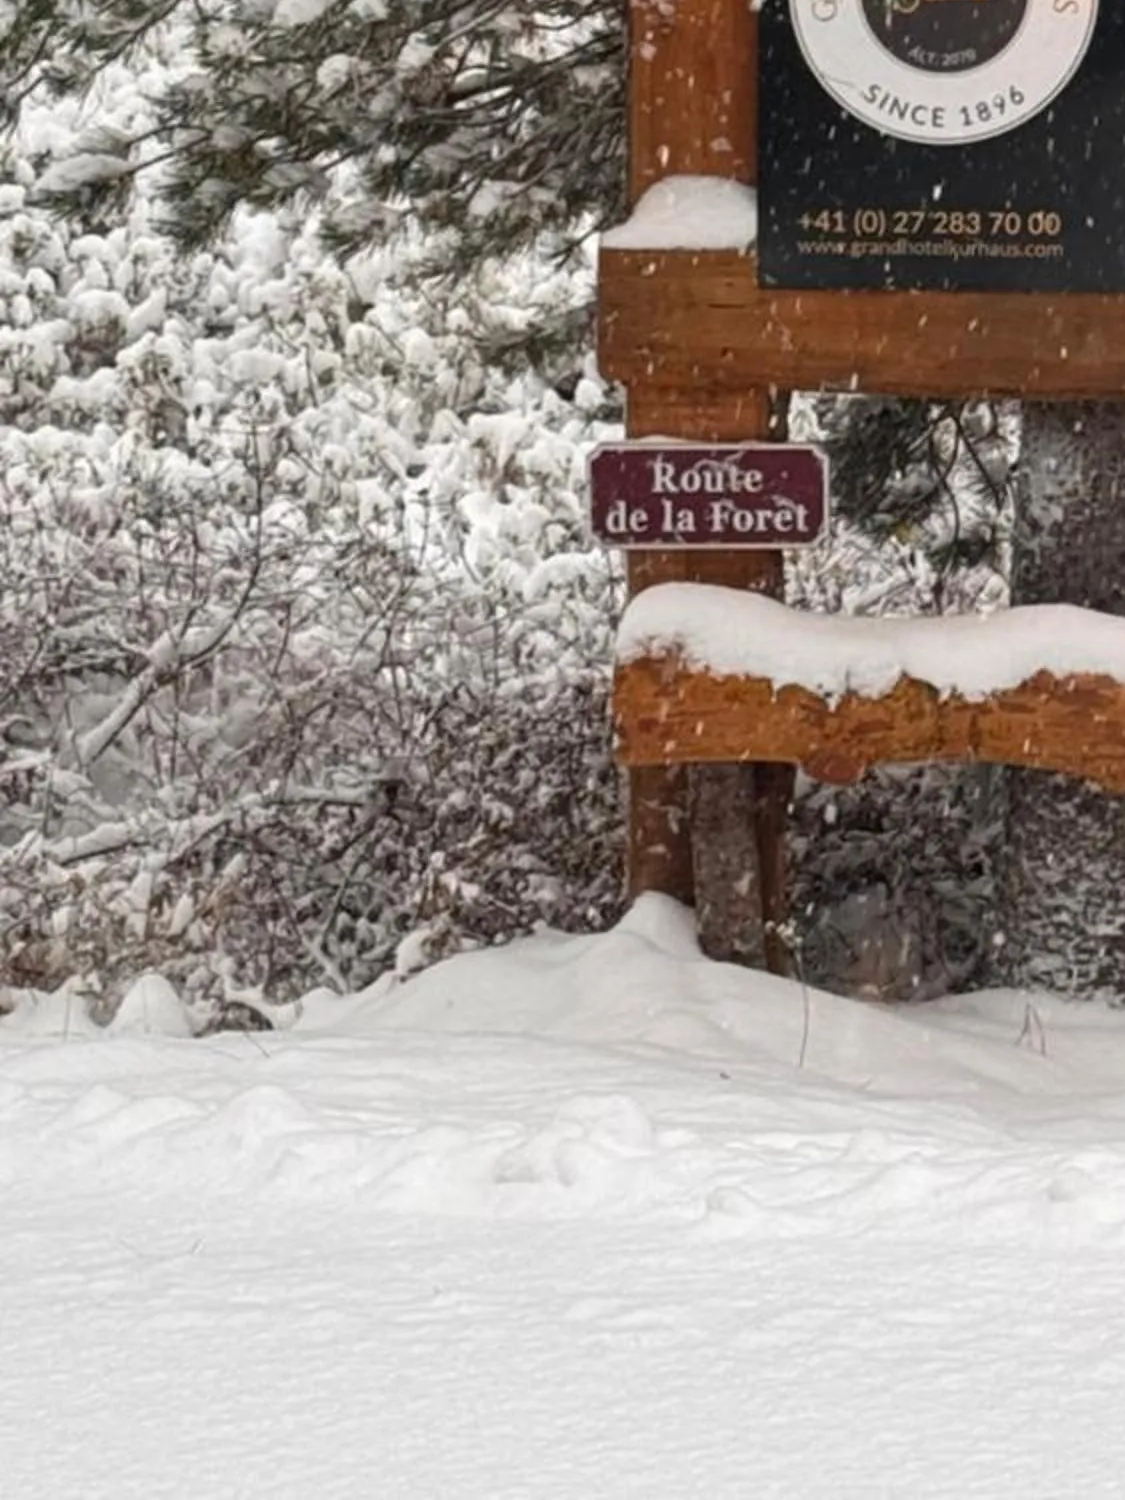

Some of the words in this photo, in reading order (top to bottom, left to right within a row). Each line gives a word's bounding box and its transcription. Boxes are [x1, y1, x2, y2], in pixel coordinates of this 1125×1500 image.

[861, 83, 945, 127] SINCE
[959, 85, 1025, 127] 1896
[797, 210, 845, 232] +41
[853, 209, 886, 237] (0)
[893, 211, 924, 234] 27
[932, 211, 980, 235] 283
[989, 212, 1021, 235] 70
[1027, 211, 1062, 236] 00
[651, 455, 763, 493] Route
[605, 501, 649, 534] de
[661, 499, 696, 533] la
